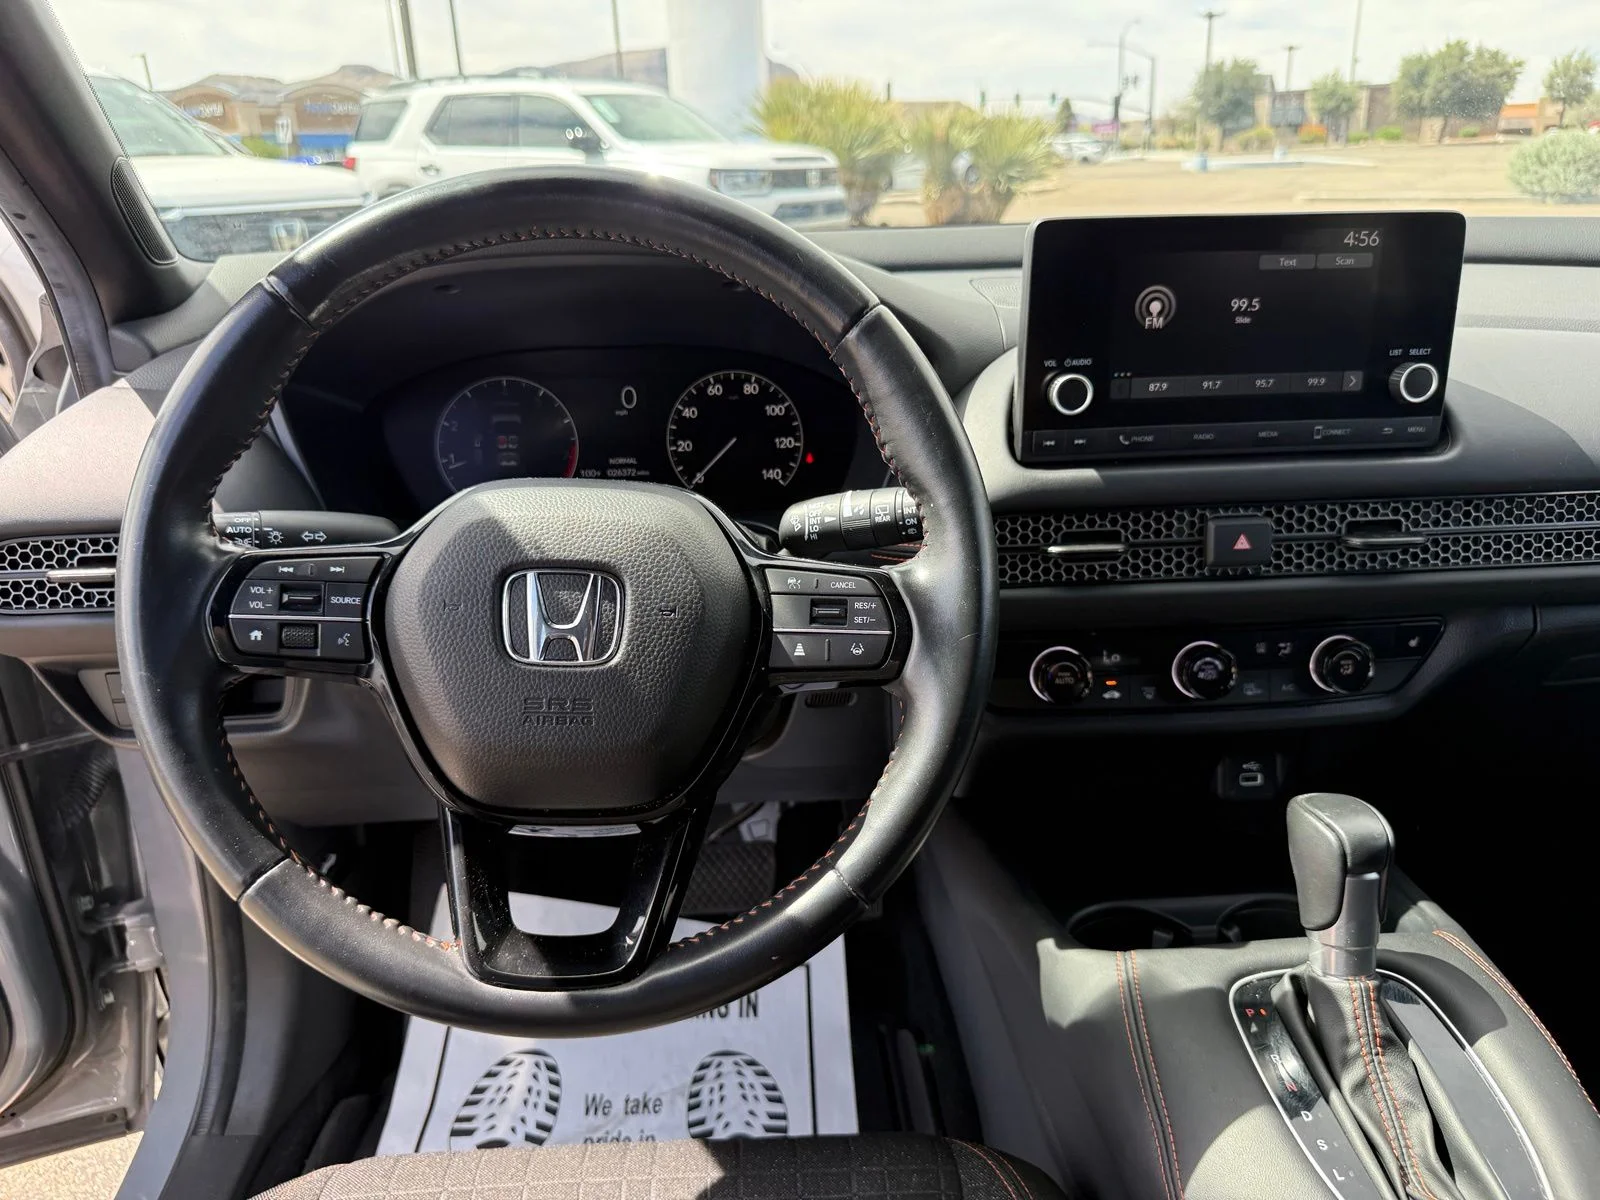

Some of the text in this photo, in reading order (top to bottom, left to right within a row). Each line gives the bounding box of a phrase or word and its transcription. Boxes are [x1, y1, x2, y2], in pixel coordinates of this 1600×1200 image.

[1343, 230, 1380, 247] 4:56
[1279, 257, 1297, 267] Text
[1335, 256, 1355, 266] Scan
[1230, 297, 1261, 312] 99.5
[1145, 317, 1163, 330] FM
[1389, 348, 1402, 357] LIST
[1409, 347, 1431, 357] SELECT
[1044, 359, 1057, 367] VOL
[1071, 358, 1092, 367] AUDIO
[1148, 382, 1168, 392] 87.9
[1202, 380, 1221, 390] 91.7
[1255, 378, 1273, 388] 95.7
[1307, 377, 1326, 387] 99.9
[707, 384, 723, 396] 60
[743, 384, 759, 395] 80
[620, 385, 638, 409] 0
[682, 407, 698, 418] 40
[765, 405, 785, 417] 100
[677, 440, 693, 452] 20
[775, 438, 795, 449] 120
[762, 469, 782, 481] 140
[903, 506, 917, 515] INT
[809, 517, 821, 525] INT
[875, 515, 891, 523] REAR
[905, 518, 917, 526] ON
[226, 526, 252, 534] AUTO
[810, 525, 819, 533] LO
[830, 581, 857, 589] CANCEL
[330, 596, 361, 605] SOURCE
[522, 698, 594, 712] SRS
[522, 715, 595, 726] AIRBAG
[1245, 1008, 1255, 1017] P
[585, 1091, 663, 1116] We take
[1301, 1111, 1312, 1122] D
[1316, 1139, 1328, 1150] S
[1332, 1168, 1345, 1181] L
